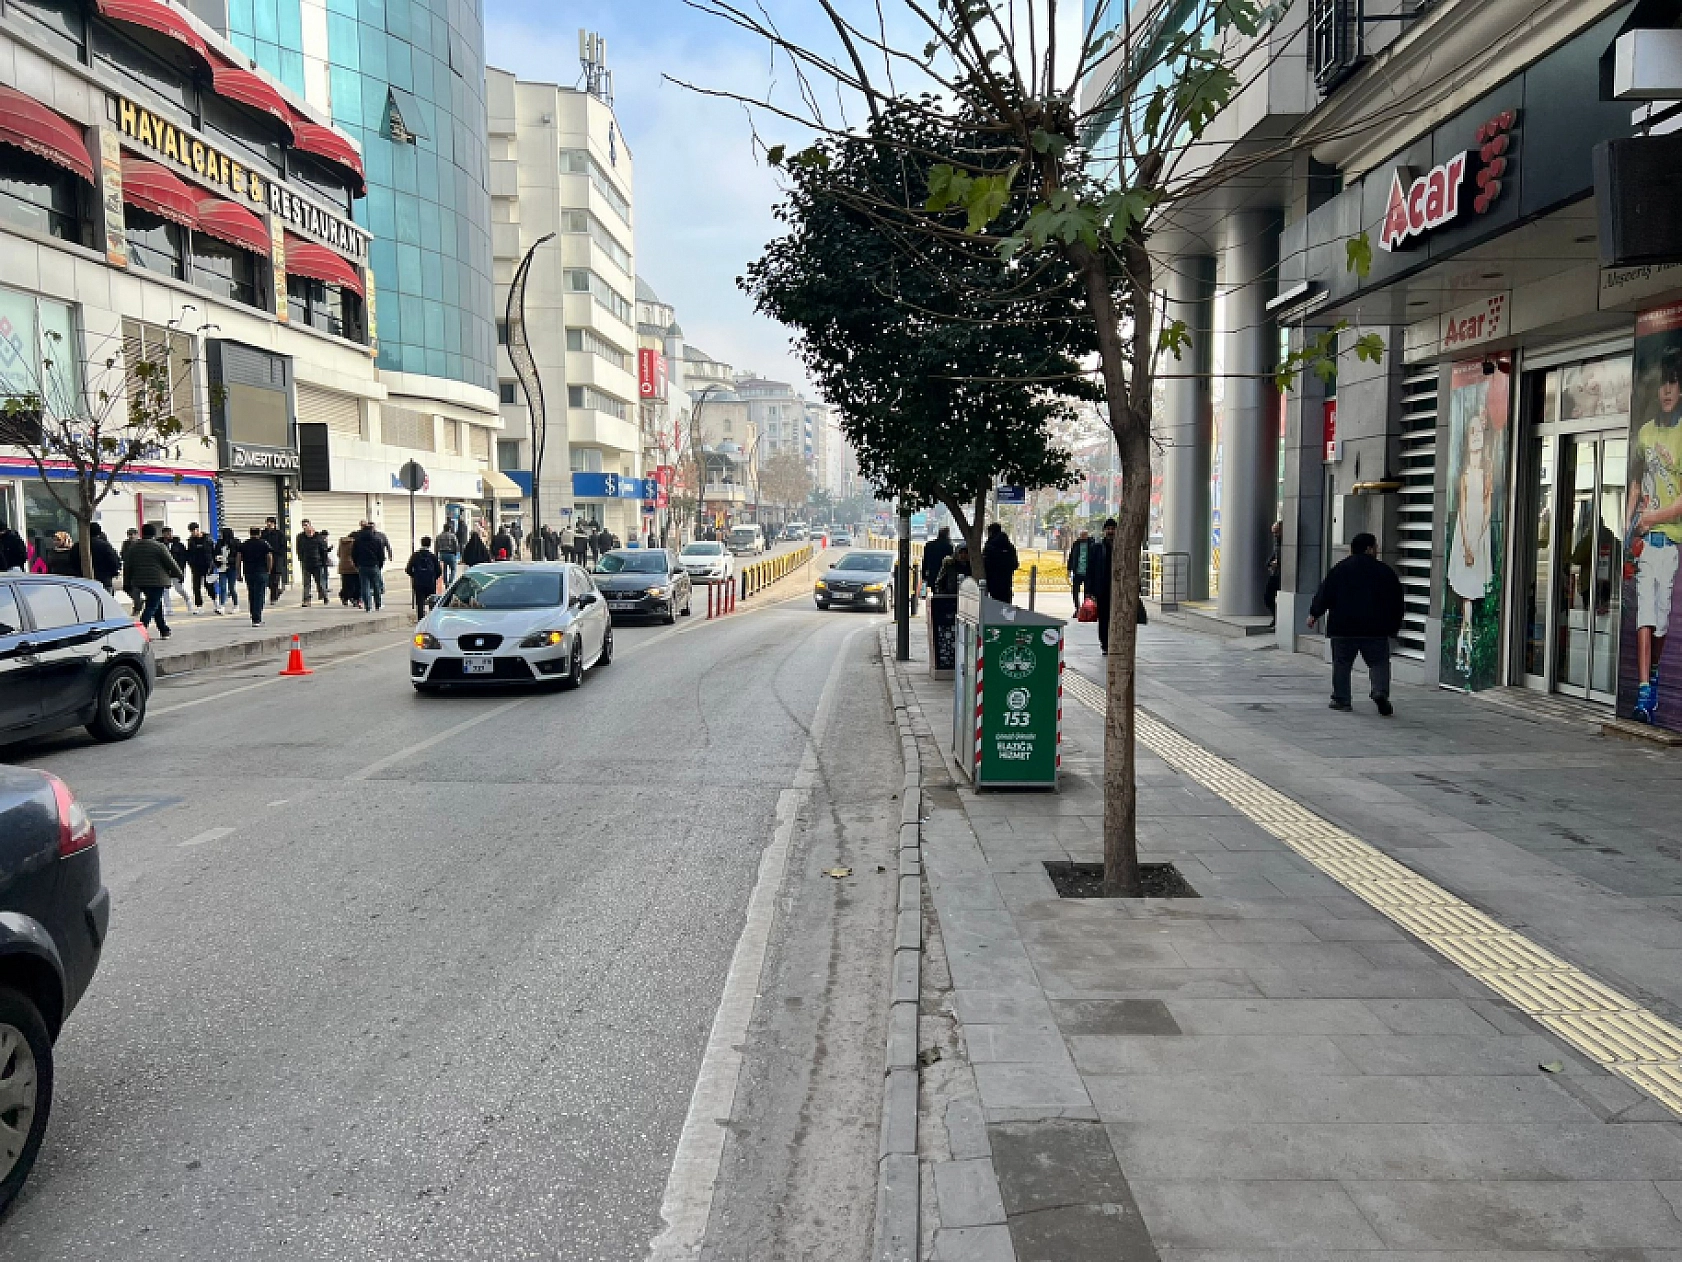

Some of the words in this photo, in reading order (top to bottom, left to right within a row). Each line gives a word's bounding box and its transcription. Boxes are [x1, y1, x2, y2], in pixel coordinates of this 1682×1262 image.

[270, 183, 366, 257] RESTAURANT
[1379, 149, 1468, 252] Acar
[1444, 313, 1486, 347] Acar
[1003, 711, 1031, 727] 153
